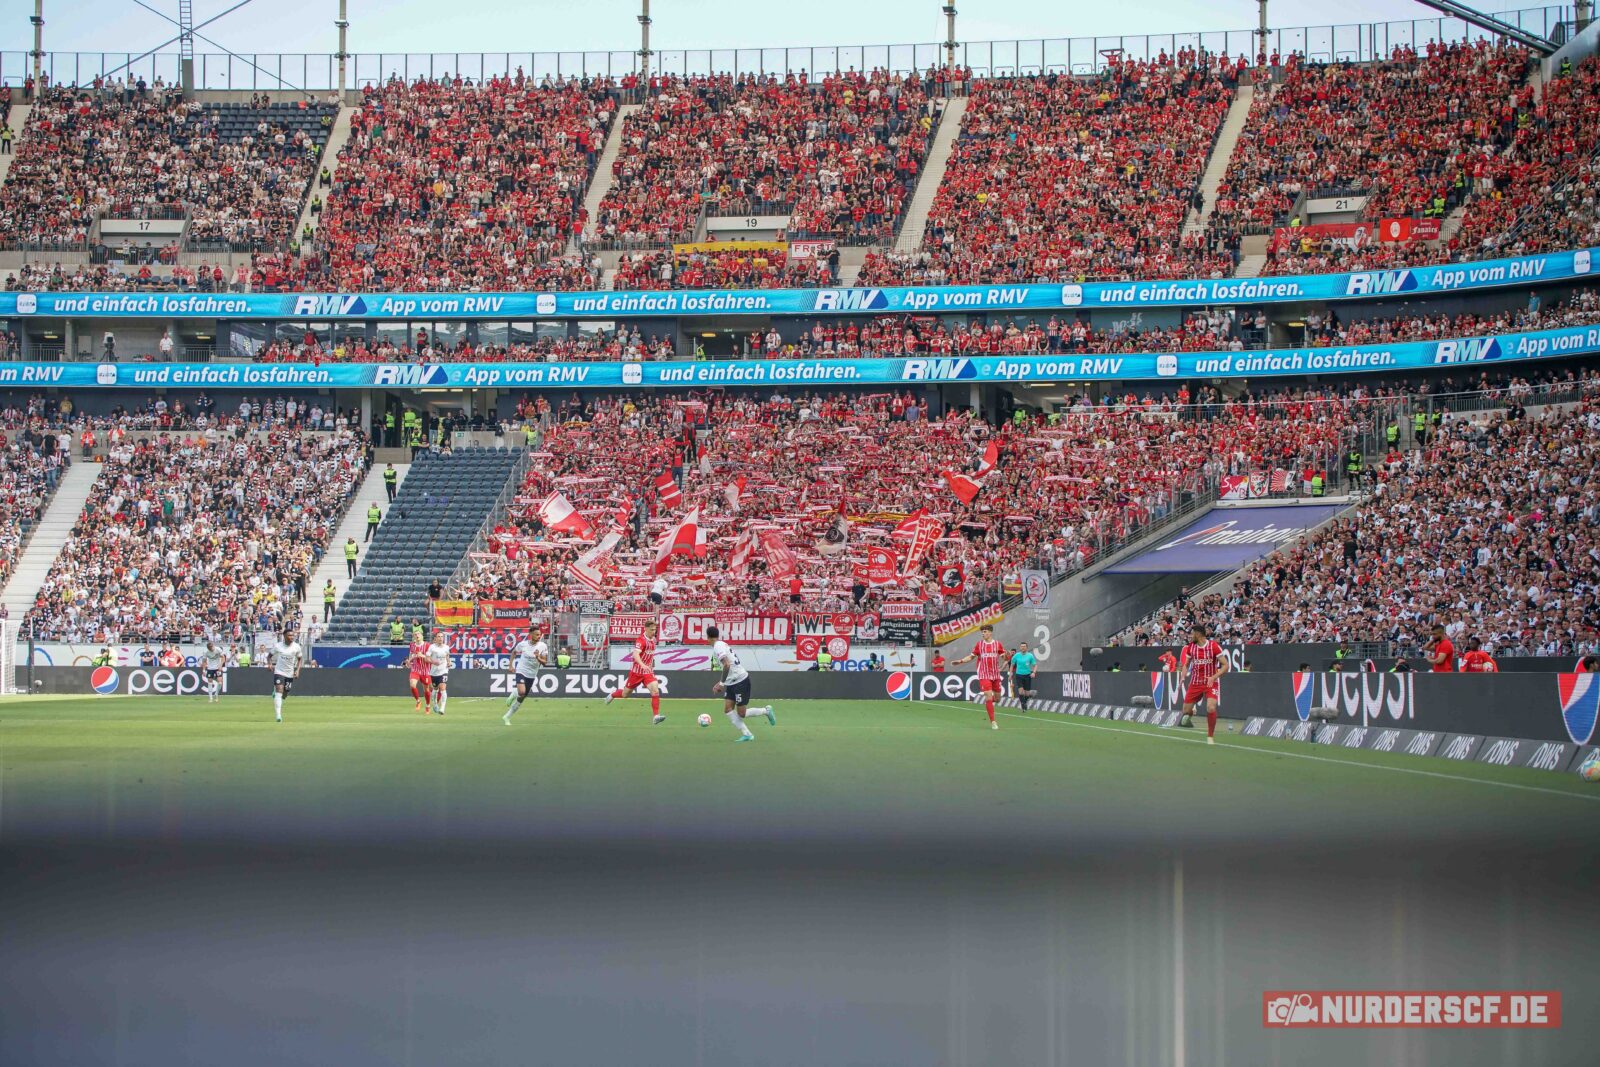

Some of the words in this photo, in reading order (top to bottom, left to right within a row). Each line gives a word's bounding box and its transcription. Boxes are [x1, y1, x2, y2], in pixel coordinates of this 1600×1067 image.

[1336, 200, 1348, 209] 21
[138, 222, 151, 231] 17
[745, 218, 758, 228] 19
[1346, 270, 1410, 295] RMV
[1432, 270, 1466, 288] App
[1469, 265, 1506, 282] vom
[1509, 259, 1546, 277] RMV
[814, 290, 879, 310] RMV
[902, 291, 939, 309] App
[943, 293, 983, 306] vom
[986, 288, 1029, 304] RMV
[1100, 285, 1136, 302] und
[1139, 283, 1207, 301] einfach
[1212, 281, 1304, 299] losfahren.
[54, 296, 89, 312] und
[92, 296, 158, 312] einfach
[162, 295, 252, 312] losfahren.
[294, 295, 357, 315] RMV
[380, 298, 417, 316] App
[421, 300, 460, 312] vom
[463, 297, 505, 312] RMV
[573, 295, 609, 311] und
[611, 294, 677, 311] einfach
[681, 293, 772, 310] losfahren.
[1434, 338, 1495, 364] RMV
[1517, 337, 1548, 357] App
[1551, 334, 1584, 351] vom
[902, 359, 970, 380] RMV
[994, 361, 1031, 377] App
[1035, 363, 1076, 375] vom
[1080, 358, 1123, 374] RMV
[1194, 356, 1231, 372] und
[1234, 354, 1303, 371] einfach
[1307, 350, 1396, 369] losfahren.
[22, 366, 64, 382] RMV
[134, 367, 171, 382] und
[173, 366, 240, 382] einfach
[243, 365, 334, 382] losfahren.
[374, 365, 440, 385] RMV
[464, 367, 500, 385] App
[504, 370, 543, 382] vom
[548, 366, 590, 382] RMV
[660, 365, 696, 381] und
[698, 364, 765, 380] einfach
[769, 363, 861, 380] losfahren.
[611, 626, 642, 634] ULTRAS
[796, 614, 832, 634] IWF
[931, 602, 1004, 641] FREIBURG
[1033, 624, 1052, 661] 3
[919, 672, 1013, 701] pepi
